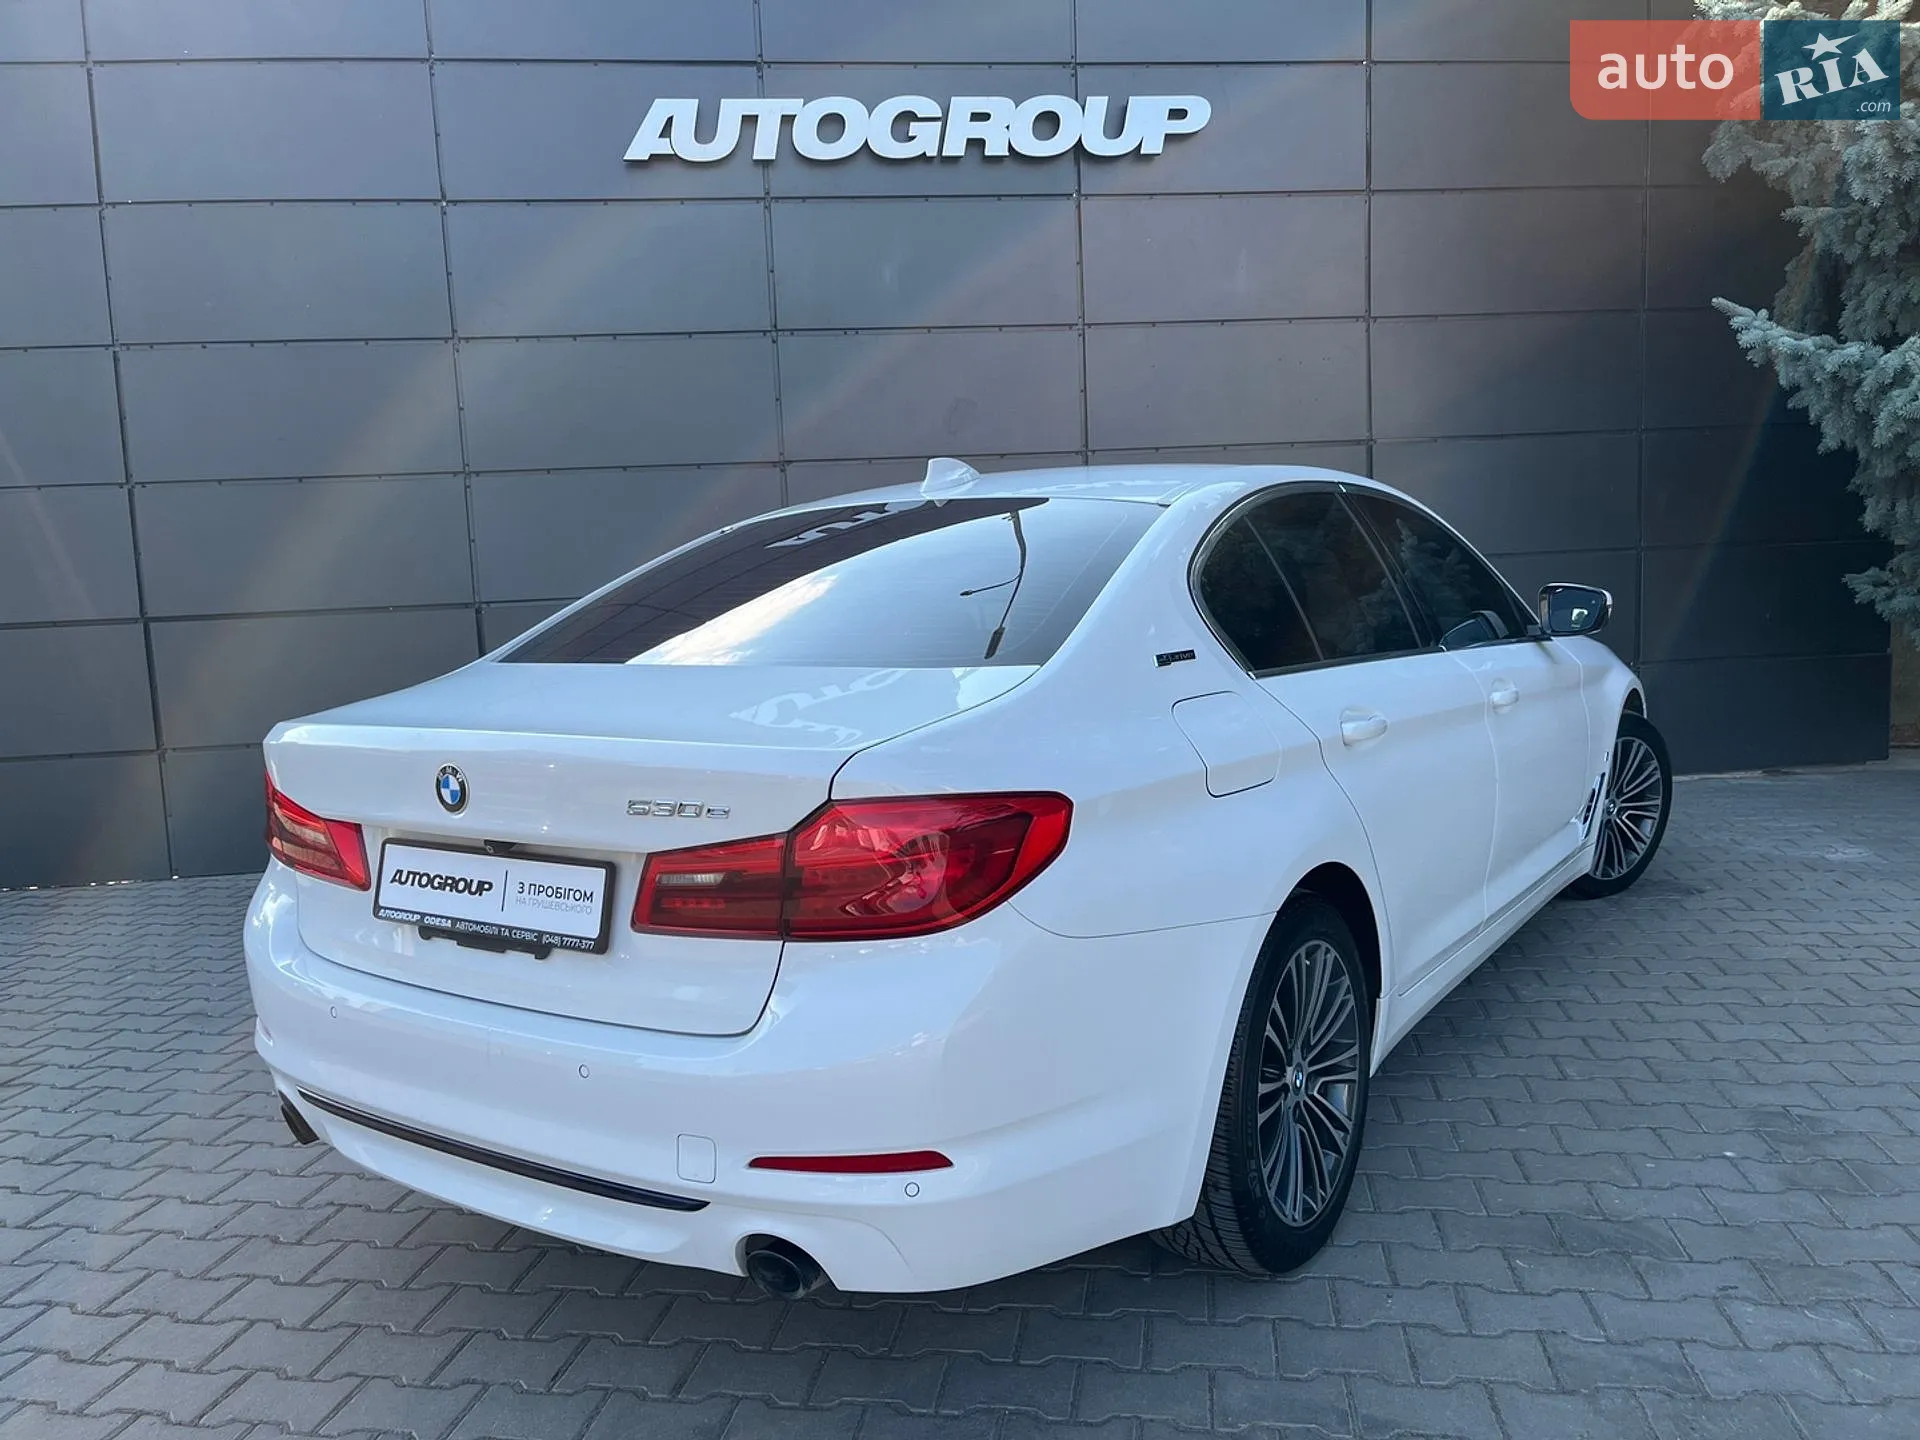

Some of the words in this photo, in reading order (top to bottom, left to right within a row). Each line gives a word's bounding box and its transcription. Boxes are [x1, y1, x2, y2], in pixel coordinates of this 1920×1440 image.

[623, 95, 1212, 162] AUTOGROUP
[390, 869, 493, 896] AUTOGROUP
[528, 883, 594, 903] ПРОБІГОМ
[424, 916, 452, 928] ODESA
